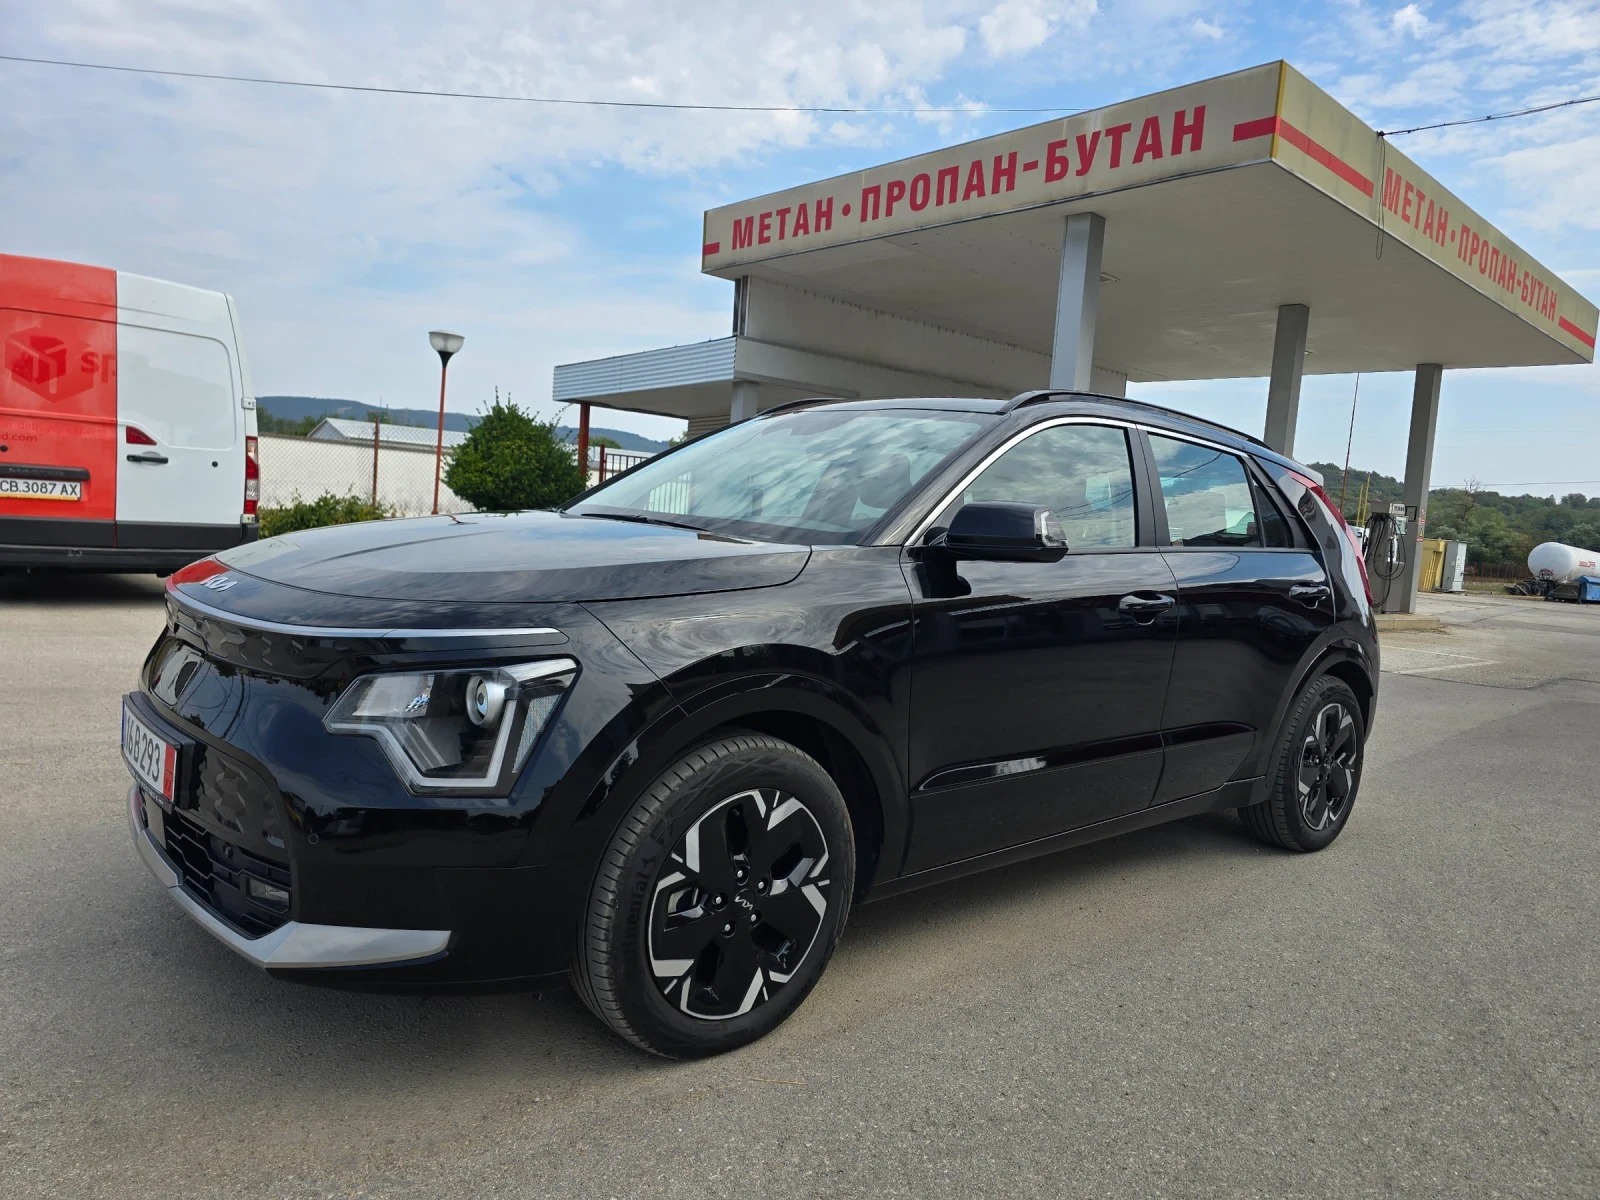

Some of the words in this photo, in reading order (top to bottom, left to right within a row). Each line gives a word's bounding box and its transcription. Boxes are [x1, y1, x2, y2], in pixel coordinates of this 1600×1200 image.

[732, 196, 834, 250] МЕТАН
[860, 105, 1207, 223] ПРОПАН-БУТАН
[1382, 166, 1449, 248] МЕТАН
[1457, 223, 1558, 322] ПРОПАН-БУТАН
[60, 483, 78, 496] AX
